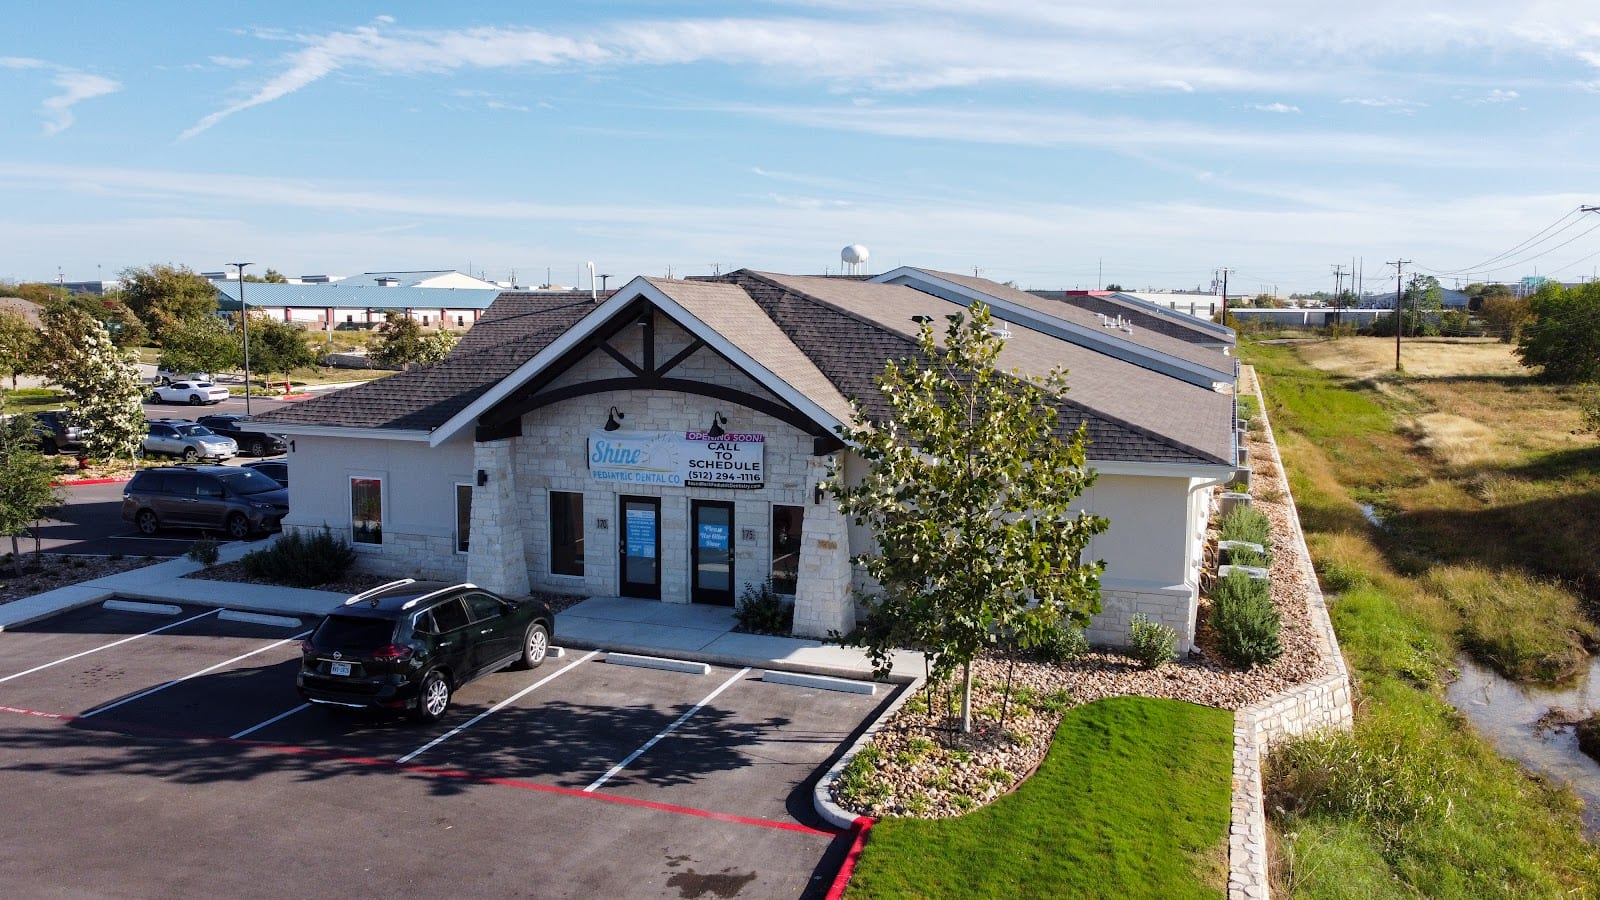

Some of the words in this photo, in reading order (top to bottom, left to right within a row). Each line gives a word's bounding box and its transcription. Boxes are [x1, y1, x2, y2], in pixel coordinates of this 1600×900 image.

[688, 432, 730, 441] OPENING
[732, 434, 763, 442] SOON!
[289, 440, 296, 453] 1
[707, 442, 741, 451] CALL
[591, 440, 641, 465] Shine
[715, 451, 733, 460] TO
[688, 459, 760, 471] SCHEDULE
[592, 470, 633, 481] PEDIATRIC
[635, 472, 666, 483] DENTAL
[688, 471, 713, 481] (512)
[716, 472, 761, 481] 294-1116
